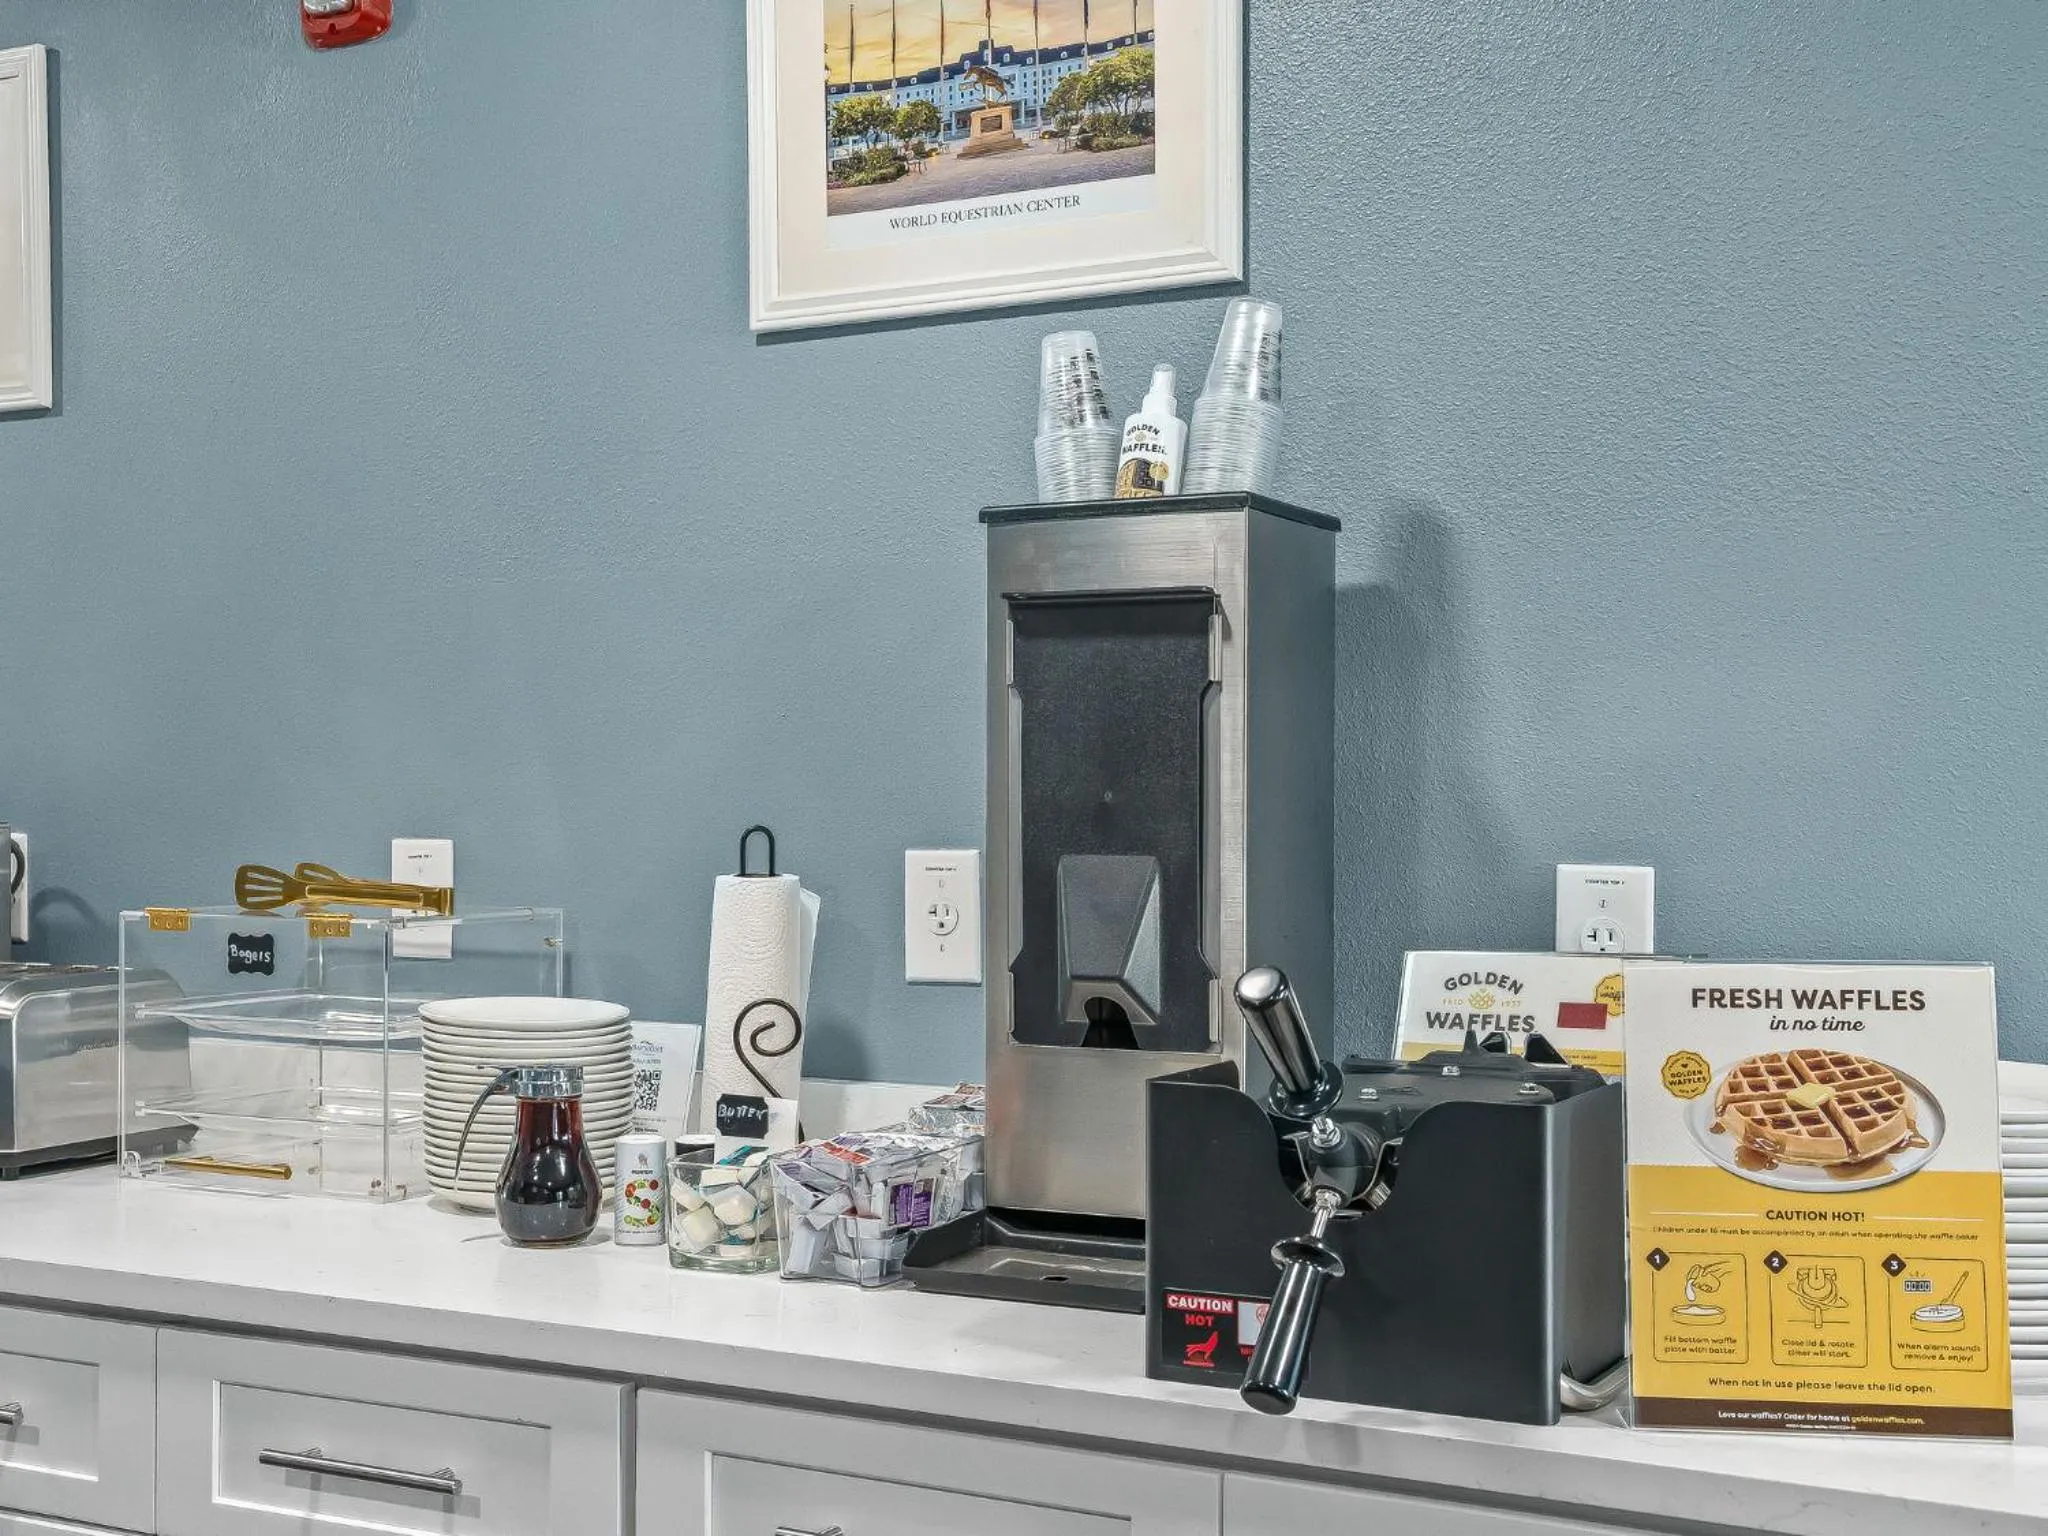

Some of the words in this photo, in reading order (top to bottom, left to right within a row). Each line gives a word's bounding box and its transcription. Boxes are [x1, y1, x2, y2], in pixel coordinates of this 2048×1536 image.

[889, 213, 937, 230] WORLD
[942, 202, 1024, 223] EQUESTRIAN
[1027, 194, 1080, 213] CENTER
[1444, 971, 1524, 995] GOLDEN
[1691, 988, 1783, 1010] FRESH
[1791, 989, 1926, 1011] WAFFLES
[1426, 1011, 1536, 1033] WAFFLES
[1769, 1015, 1789, 1031] in
[1792, 1018, 1818, 1031] no
[1821, 1015, 1866, 1032] time
[1766, 1210, 1828, 1221] CAUTION
[1832, 1211, 1865, 1222] HOT!
[1654, 1254, 1660, 1264] 1
[1771, 1257, 1780, 1267] 2
[1890, 1260, 1898, 1270] 3
[1168, 1295, 1233, 1312] CAUTION
[1185, 1313, 1215, 1327] HOT
[1678, 1336, 1709, 1344] bottom
[1711, 1336, 1737, 1344] waffle
[1664, 1346, 1687, 1354] plate
[1689, 1346, 1707, 1354] with
[1924, 1343, 1949, 1351] alarm
[1951, 1344, 1980, 1352] sounds
[1709, 1377, 1739, 1387] When
[1742, 1379, 1760, 1387] not
[1762, 1379, 1771, 1387] in
[1775, 1380, 1793, 1388] use
[1796, 1380, 1831, 1392] please
[1835, 1381, 1864, 1391] leave
[1867, 1381, 1886, 1391] the
[1889, 1382, 1901, 1392] lid
[1718, 1410, 1736, 1418] Love
[1751, 1411, 1782, 1420] waffles?
[1783, 1412, 1805, 1420] Order
[1807, 1413, 1817, 1421] for
